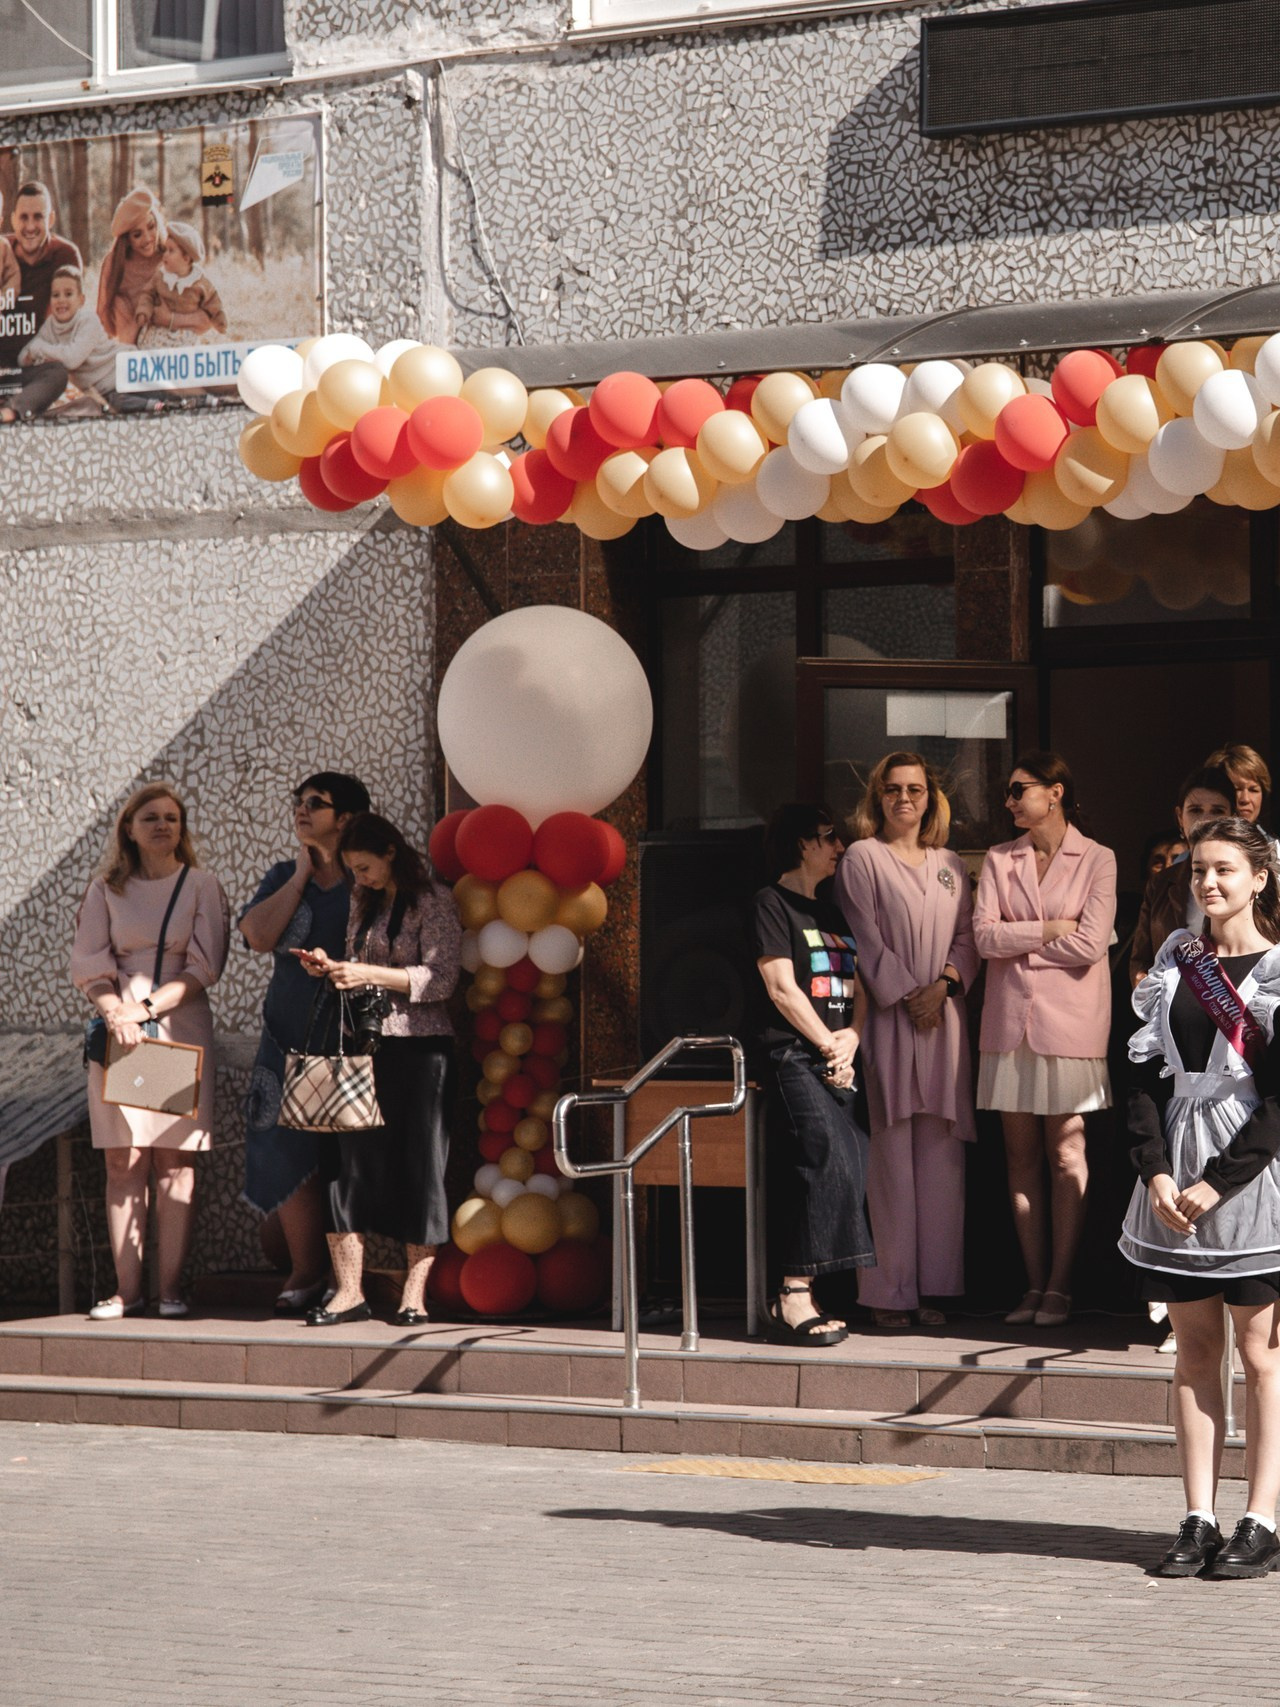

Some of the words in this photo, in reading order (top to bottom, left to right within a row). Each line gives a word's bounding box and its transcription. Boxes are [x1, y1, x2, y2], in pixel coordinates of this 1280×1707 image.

[128, 353, 189, 383] ВАЖНО
[194, 349, 241, 379] БЫТЬ
[1209, 1002, 1221, 1017] СОШ
